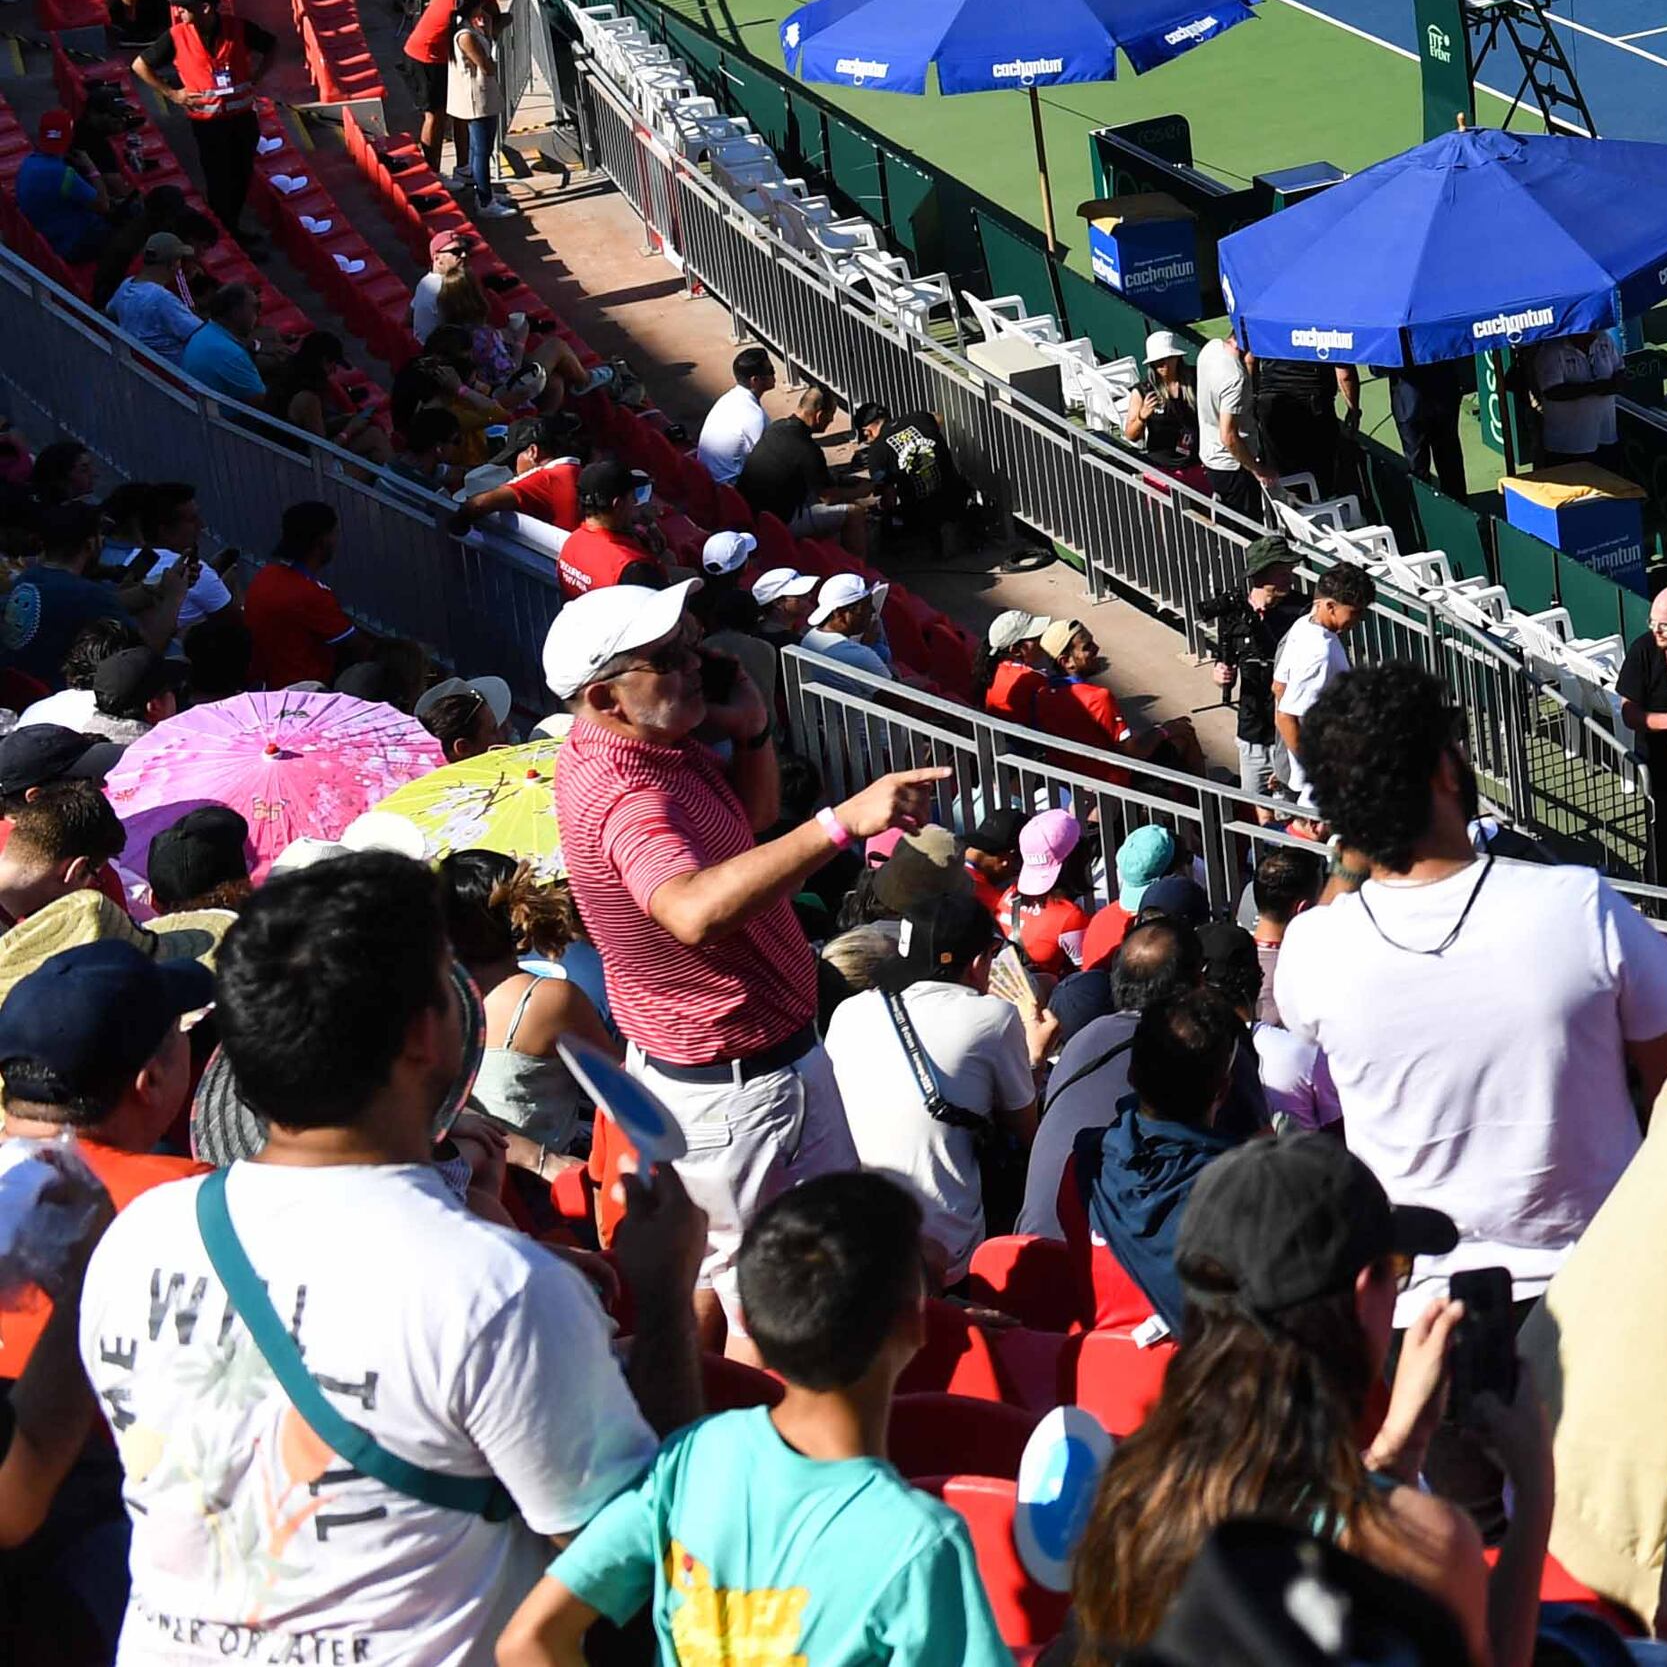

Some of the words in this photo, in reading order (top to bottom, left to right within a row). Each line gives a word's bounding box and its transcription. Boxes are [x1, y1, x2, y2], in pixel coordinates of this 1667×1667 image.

[1430, 47, 1451, 63] EVENT
[992, 57, 1063, 78] cachantun
[1124, 261, 1194, 288] cachantun
[1472, 306, 1554, 338] cachantun
[1625, 358, 1660, 378] sen
